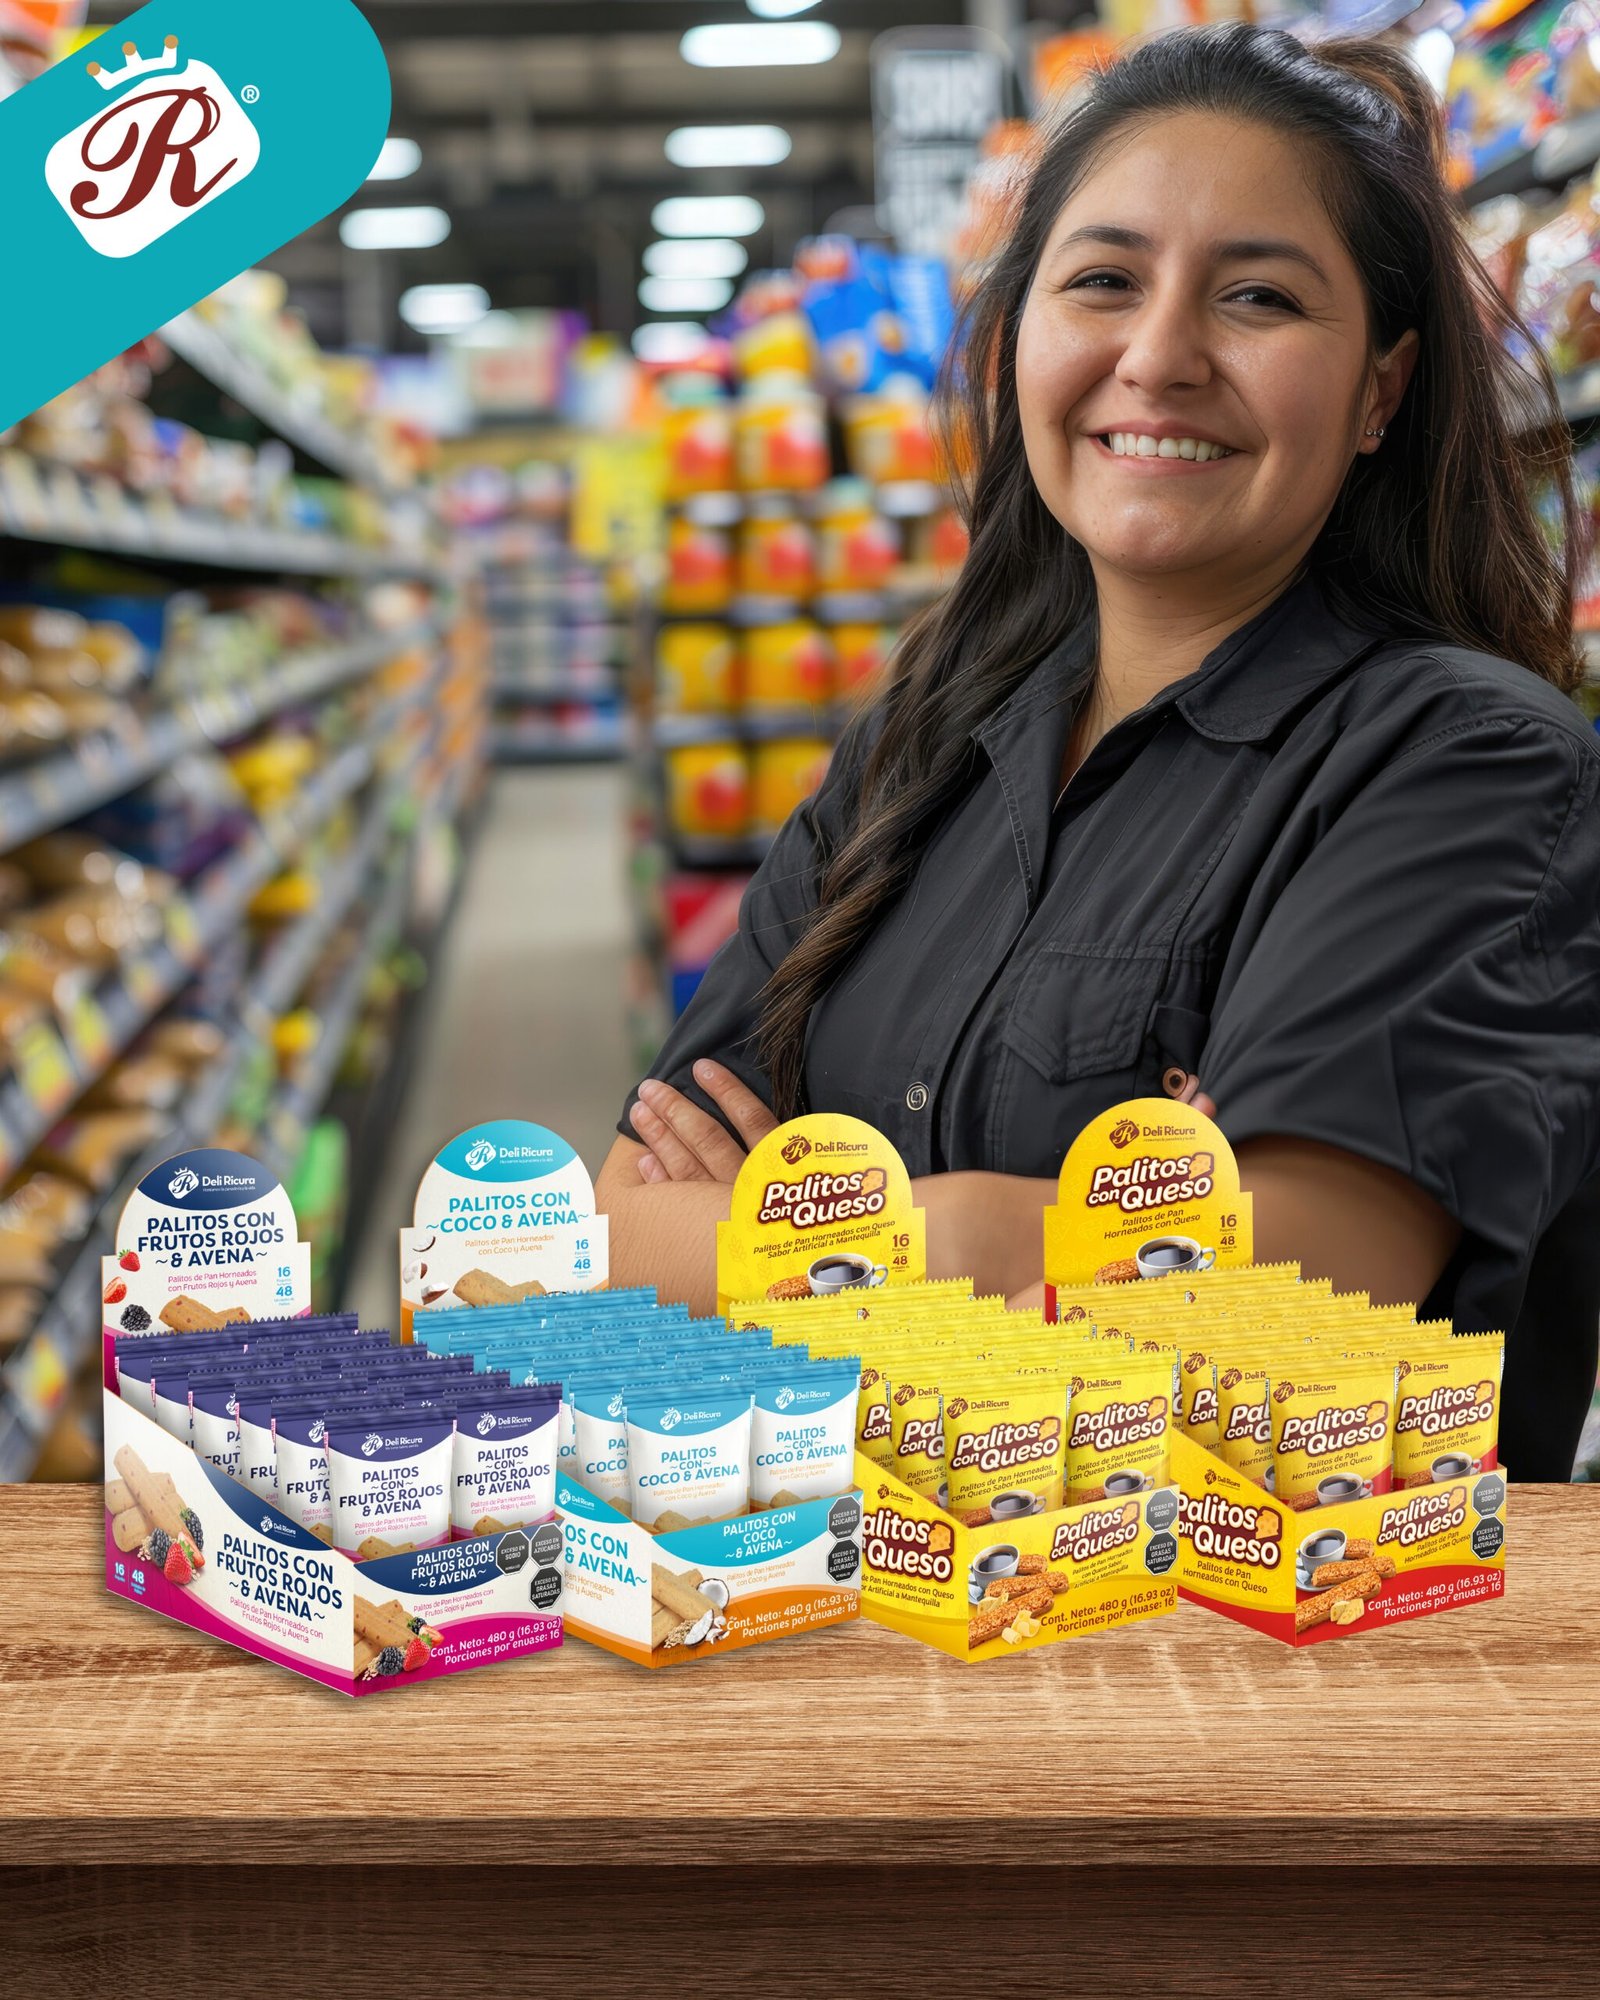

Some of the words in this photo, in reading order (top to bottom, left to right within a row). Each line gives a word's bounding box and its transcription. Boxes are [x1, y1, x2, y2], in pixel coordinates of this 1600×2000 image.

[1143, 1126, 1162, 1137] Deli
[1165, 1126, 1195, 1136] Ricura
[500, 1148, 519, 1157] Deli
[521, 1147, 553, 1156] Ricura
[815, 1142, 834, 1152] Deli
[837, 1141, 868, 1151] Ricura
[202, 1176, 222, 1186] Deli
[224, 1176, 255, 1185] Ricura
[1093, 1157, 1191, 1191] Palitos
[765, 1173, 863, 1207] Palitos
[1089, 1190, 1119, 1204] con
[1121, 1178, 1211, 1210] Queso
[449, 1195, 526, 1212] PALITOS
[531, 1192, 570, 1207] CON
[761, 1205, 791, 1220] con
[793, 1194, 883, 1226] Queso
[148, 1215, 228, 1233] PALITOS
[234, 1212, 275, 1228] CON
[440, 1216, 497, 1232] COCO
[518, 1211, 578, 1228] AVENA
[1104, 1223, 1153, 1240] Horneados
[1155, 1220, 1172, 1229] con
[1173, 1214, 1201, 1226] Queso
[1122, 1215, 1152, 1227] Palitos
[1154, 1212, 1166, 1220] de
[1167, 1209, 1184, 1218] Pan
[1220, 1214, 1237, 1227] 16
[138, 1232, 216, 1252] FRUTOS
[222, 1228, 284, 1246] ROJOS
[517, 1234, 554, 1243] Horneados
[576, 1239, 588, 1249] 16
[754, 1244, 782, 1254] Palitos
[783, 1241, 793, 1249] de
[812, 1229, 854, 1243] Horneados
[854, 1226, 870, 1234] con
[872, 1220, 895, 1231] Queso
[768, 1249, 791, 1259] Sabor
[793, 1241, 827, 1254] Artificial
[836, 1230, 881, 1245] Mantequilla
[893, 1234, 909, 1247] 16
[1220, 1236, 1235, 1245] 48
[188, 1248, 254, 1266] AVENA
[574, 1259, 590, 1269] 48
[893, 1256, 907, 1265] 48
[168, 1275, 192, 1283] Palitos
[220, 1270, 256, 1279] Horneados
[278, 1267, 290, 1277] 16
[183, 1282, 207, 1290] Frutos
[208, 1281, 228, 1289] Rojos
[276, 1286, 292, 1296] 48
[1298, 1385, 1312, 1394] Deli
[1313, 1384, 1336, 1392] Ricura
[971, 1401, 985, 1410] Deli
[987, 1400, 1009, 1409] Ricura
[1401, 1385, 1476, 1416] Palitos
[684, 1413, 697, 1421] Deli
[699, 1411, 721, 1419] Ricura
[1074, 1401, 1148, 1432] Palitos
[1284, 1406, 1366, 1436] Palitos
[1397, 1416, 1421, 1430] con
[1422, 1403, 1492, 1432] Queso
[385, 1438, 399, 1446] Deli
[400, 1436, 422, 1445] Ricura
[776, 1427, 826, 1442] PALITOS
[957, 1421, 1039, 1452] Palitos
[1070, 1432, 1094, 1446] con
[1095, 1419, 1164, 1447] Queso
[1279, 1436, 1307, 1451] con
[1308, 1422, 1386, 1453] Queso
[478, 1446, 528, 1462] PALITOS
[661, 1446, 716, 1463] PALITOS
[792, 1439, 814, 1449] CON
[953, 1452, 979, 1468] con
[981, 1438, 1058, 1470] Queso
[494, 1460, 515, 1469] CON
[679, 1460, 702, 1470] CON
[756, 1452, 794, 1466] COCO
[807, 1444, 847, 1458] AVENA
[362, 1467, 419, 1483] PALITOS
[381, 1481, 404, 1490] CON
[457, 1471, 507, 1487] FRUTOS
[511, 1464, 550, 1478] ROJOS
[639, 1473, 681, 1487] COCO
[695, 1464, 740, 1479] AVENA
[340, 1492, 395, 1508] FRUTOS
[399, 1485, 443, 1499] ROJOS
[489, 1479, 530, 1494] AVENA
[375, 1499, 421, 1515] AVENA
[1382, 1492, 1450, 1532] Palitos
[1055, 1507, 1121, 1545] Palitos
[1378, 1528, 1400, 1545] con
[1400, 1507, 1464, 1544] Queso
[1050, 1543, 1073, 1559] con
[1073, 1524, 1137, 1560] Queso
[223, 1534, 288, 1569] PALITOS
[294, 1555, 333, 1584] CON
[417, 1547, 463, 1566] PALITOS
[465, 1540, 490, 1554] CON
[867, 1543, 951, 1579] Queso
[115, 1562, 124, 1576] 16
[411, 1562, 455, 1580] FRUTOS
[458, 1551, 495, 1568] ROJOS
[132, 1570, 144, 1584] 48
[217, 1552, 277, 1586] FRUTOS
[283, 1572, 343, 1610] ROJOS
[439, 1570, 476, 1586] AVENA
[254, 1586, 312, 1621] AVENA
[727, 1617, 753, 1631] Cont.
[756, 1610, 782, 1624] Neto:
[784, 1604, 802, 1616] 480
[814, 1596, 841, 1612] (16.93
[844, 1590, 857, 1603] oz)
[742, 1619, 790, 1638] Porciones
[792, 1616, 808, 1629] por
[848, 1602, 857, 1612] 16
[431, 1644, 457, 1658] Cont.
[460, 1636, 485, 1649] Neto:
[488, 1630, 505, 1643] 480
[517, 1621, 545, 1639] (16.93
[547, 1616, 561, 1630] oz)
[445, 1646, 492, 1665] Porciones
[494, 1643, 510, 1656] por
[550, 1629, 560, 1640] 16
